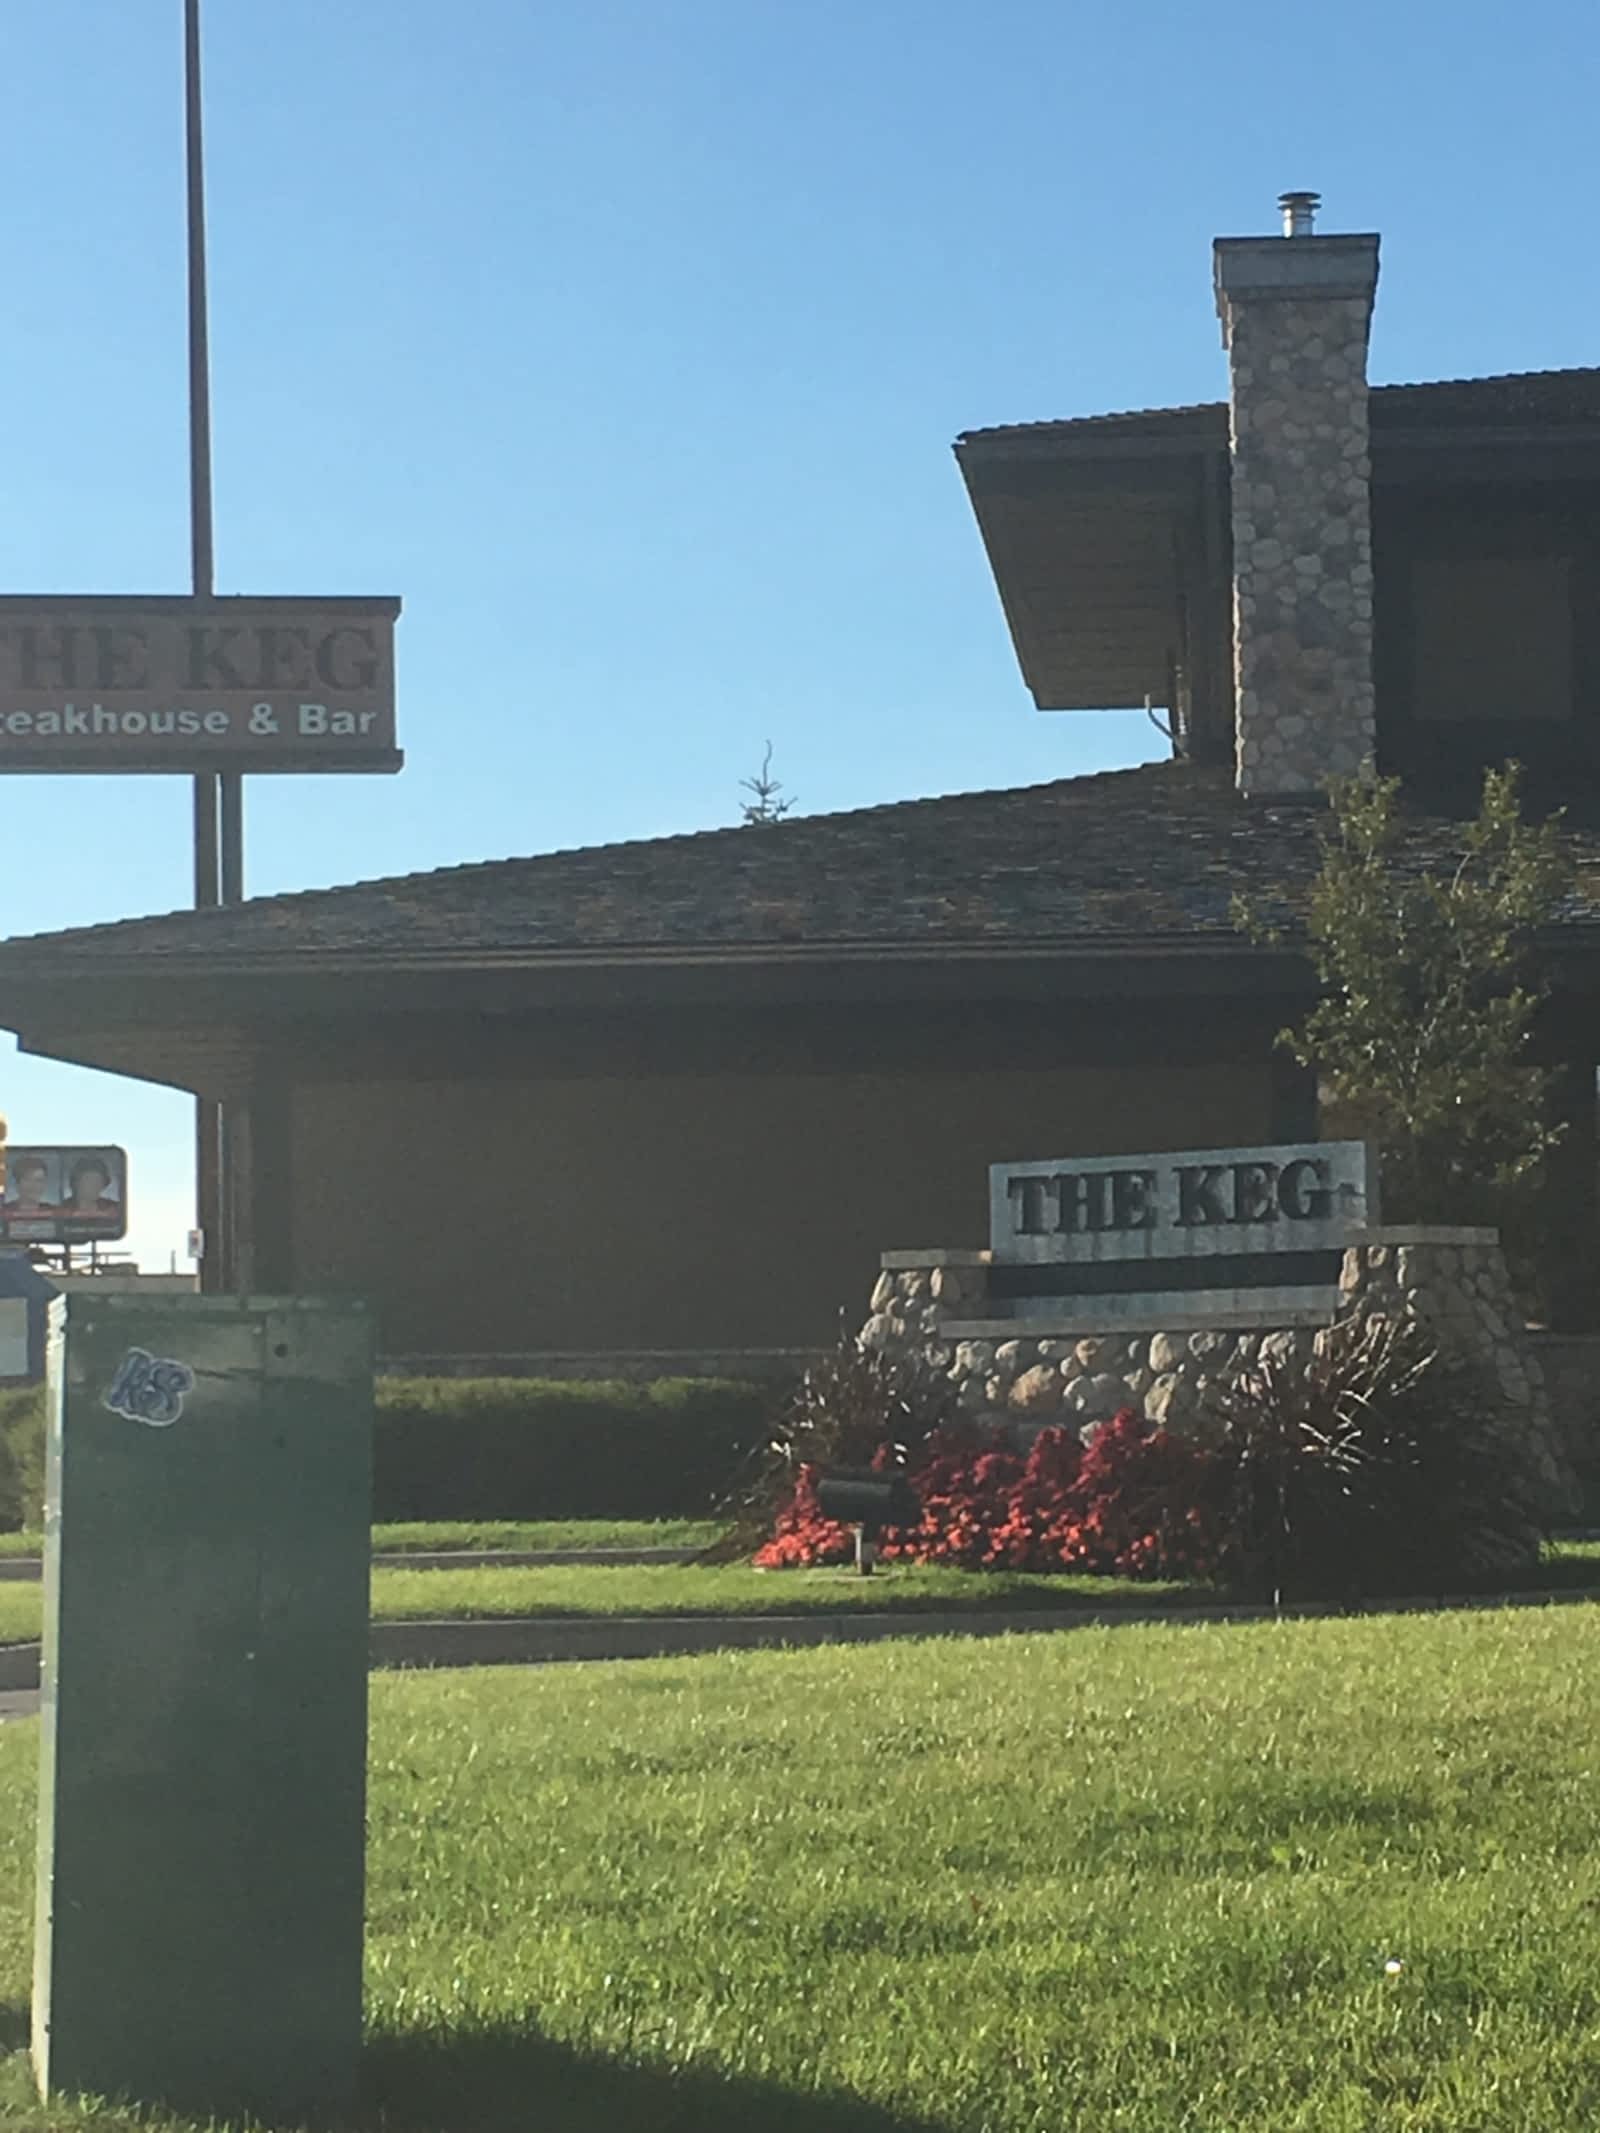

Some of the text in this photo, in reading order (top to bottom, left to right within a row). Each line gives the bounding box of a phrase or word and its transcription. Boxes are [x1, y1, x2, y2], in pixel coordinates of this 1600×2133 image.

[0, 626, 380, 690] HE KEG
[248, 703, 279, 735] &
[300, 704, 376, 735] Bar
[1007, 1158, 1331, 1235] THE KEG
